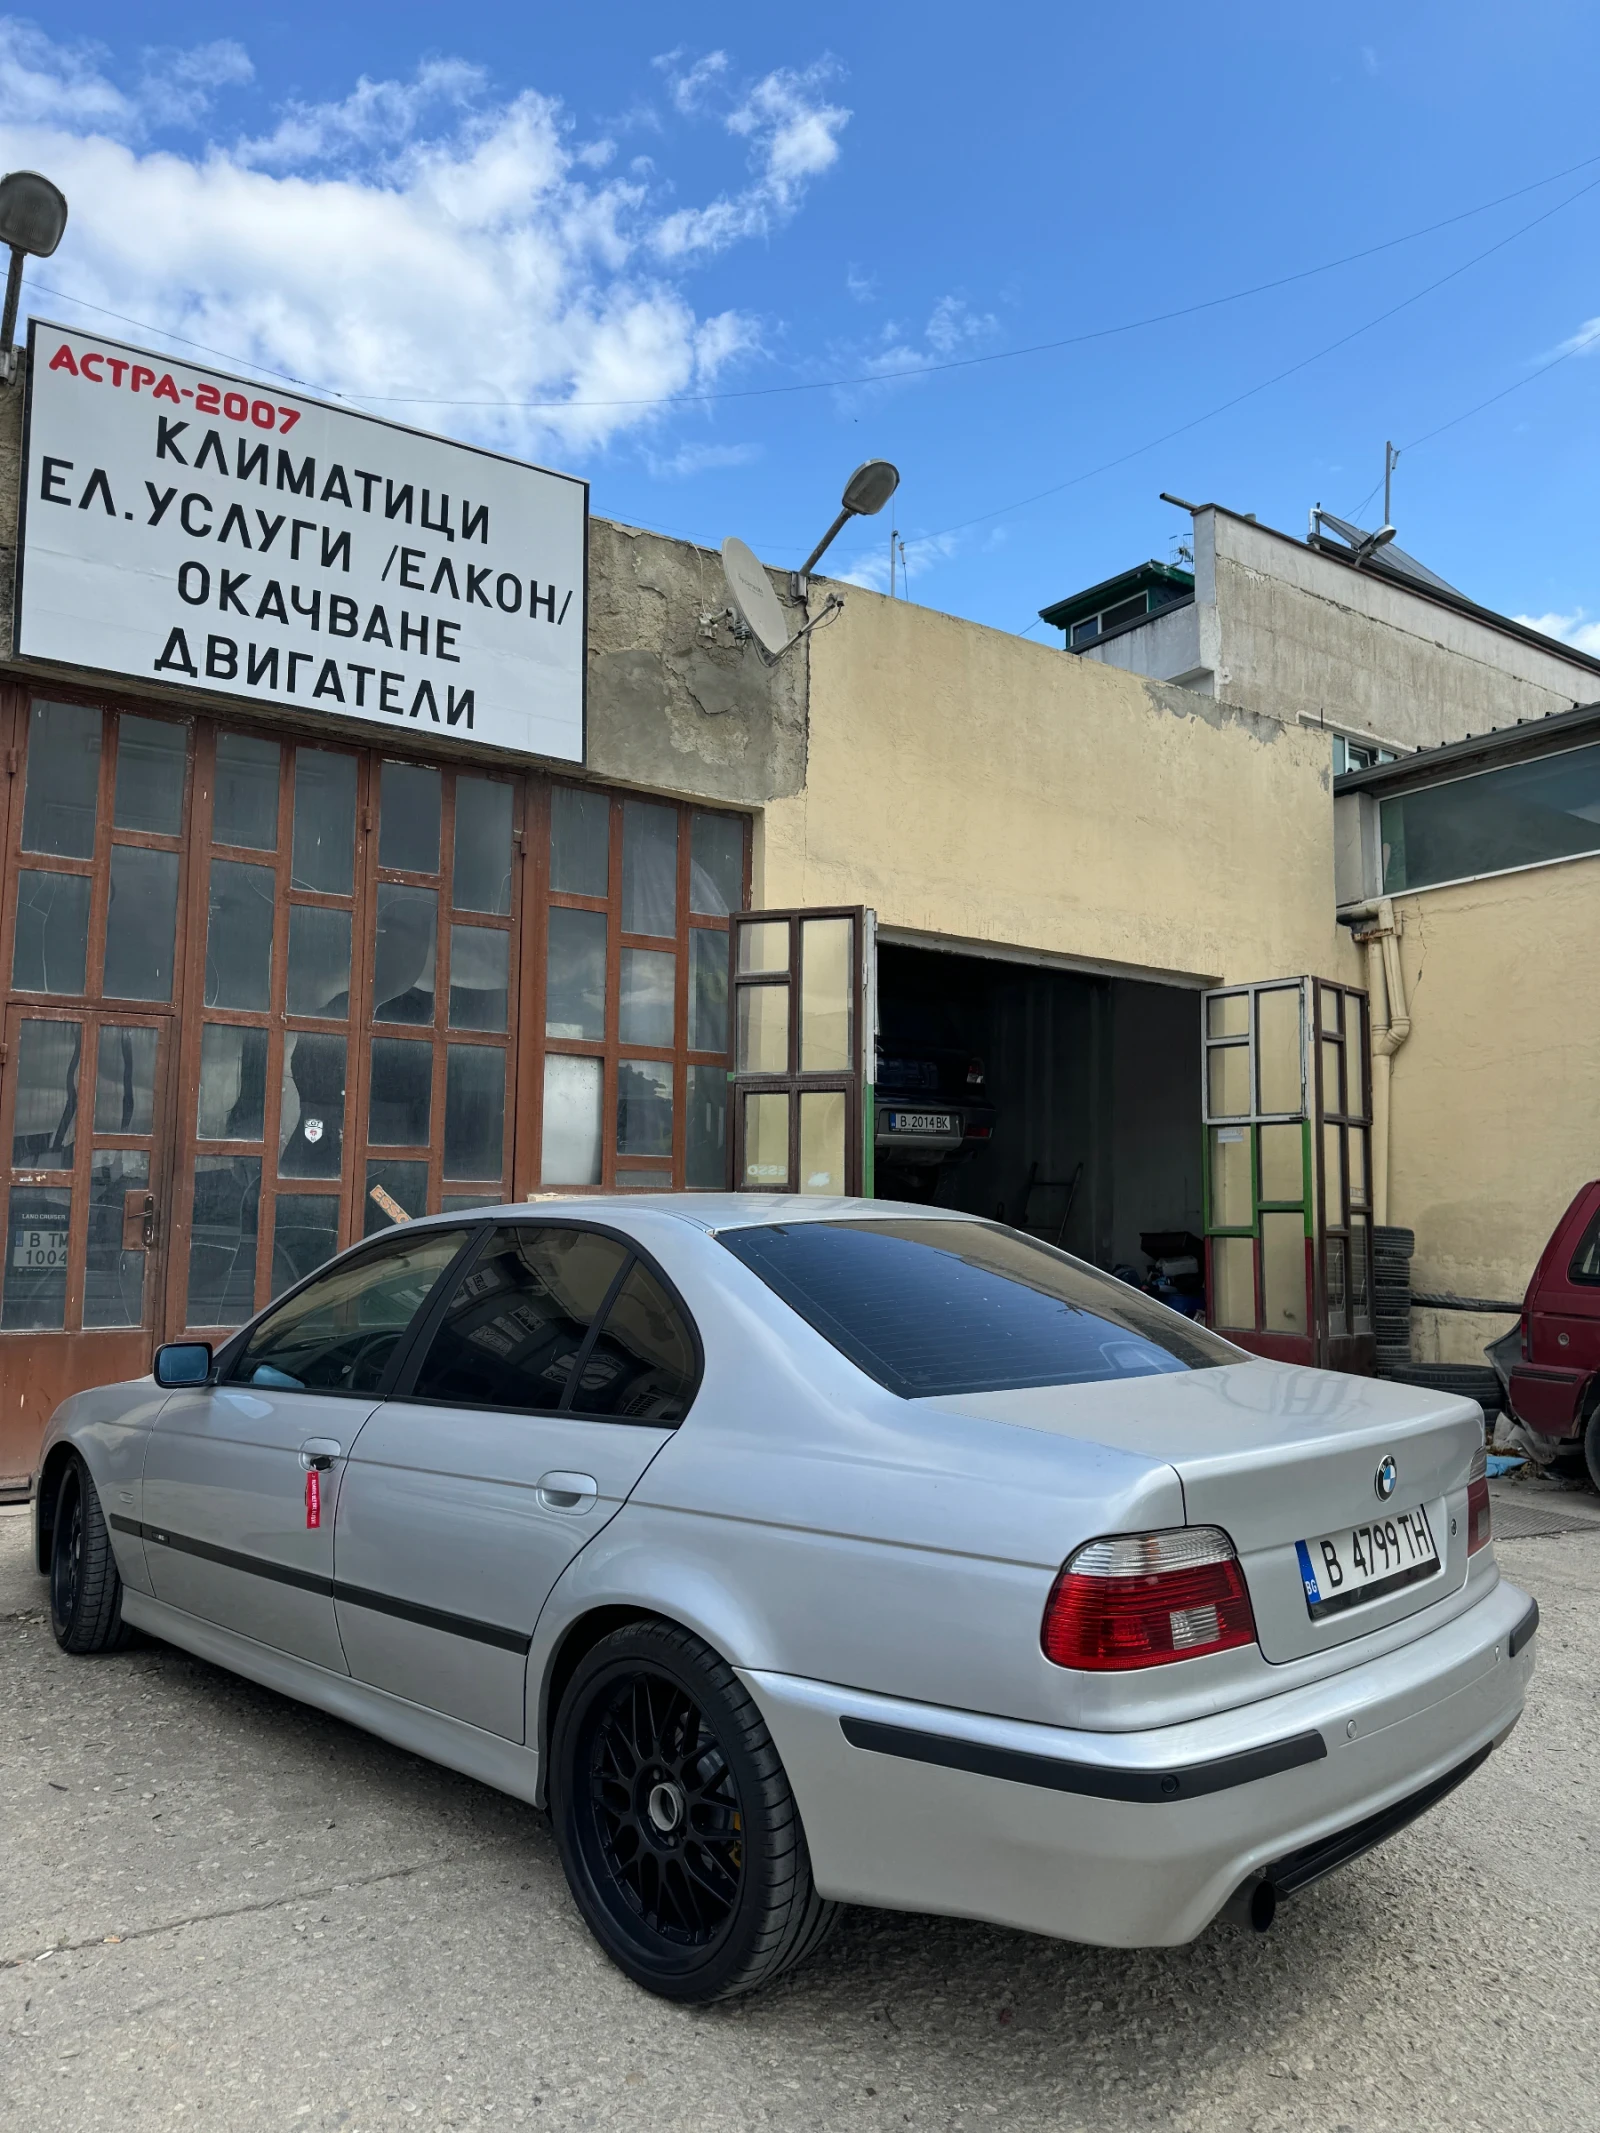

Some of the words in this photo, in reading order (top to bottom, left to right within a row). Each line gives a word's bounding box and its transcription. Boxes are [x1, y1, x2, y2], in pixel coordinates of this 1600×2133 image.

[49, 344, 301, 434] АСТРА-2007
[156, 415, 490, 544] КЛИМАТИЦИ
[40, 456, 351, 572] ЕЛ.УСЛУГИ
[381, 545, 574, 625] /ЕЛКОН/
[177, 561, 461, 662] ОКАЧВАНЕ
[154, 627, 476, 730] ДВИГАТЕЛИ
[26, 1249, 67, 1266] 1004
[30, 1232, 41, 1248] B
[48, 1232, 69, 1248] TM
[1305, 1580, 1318, 1595] BG
[1320, 1540, 1343, 1588] B
[1352, 1521, 1400, 1577] 4799
[1397, 1511, 1431, 1559] TH
